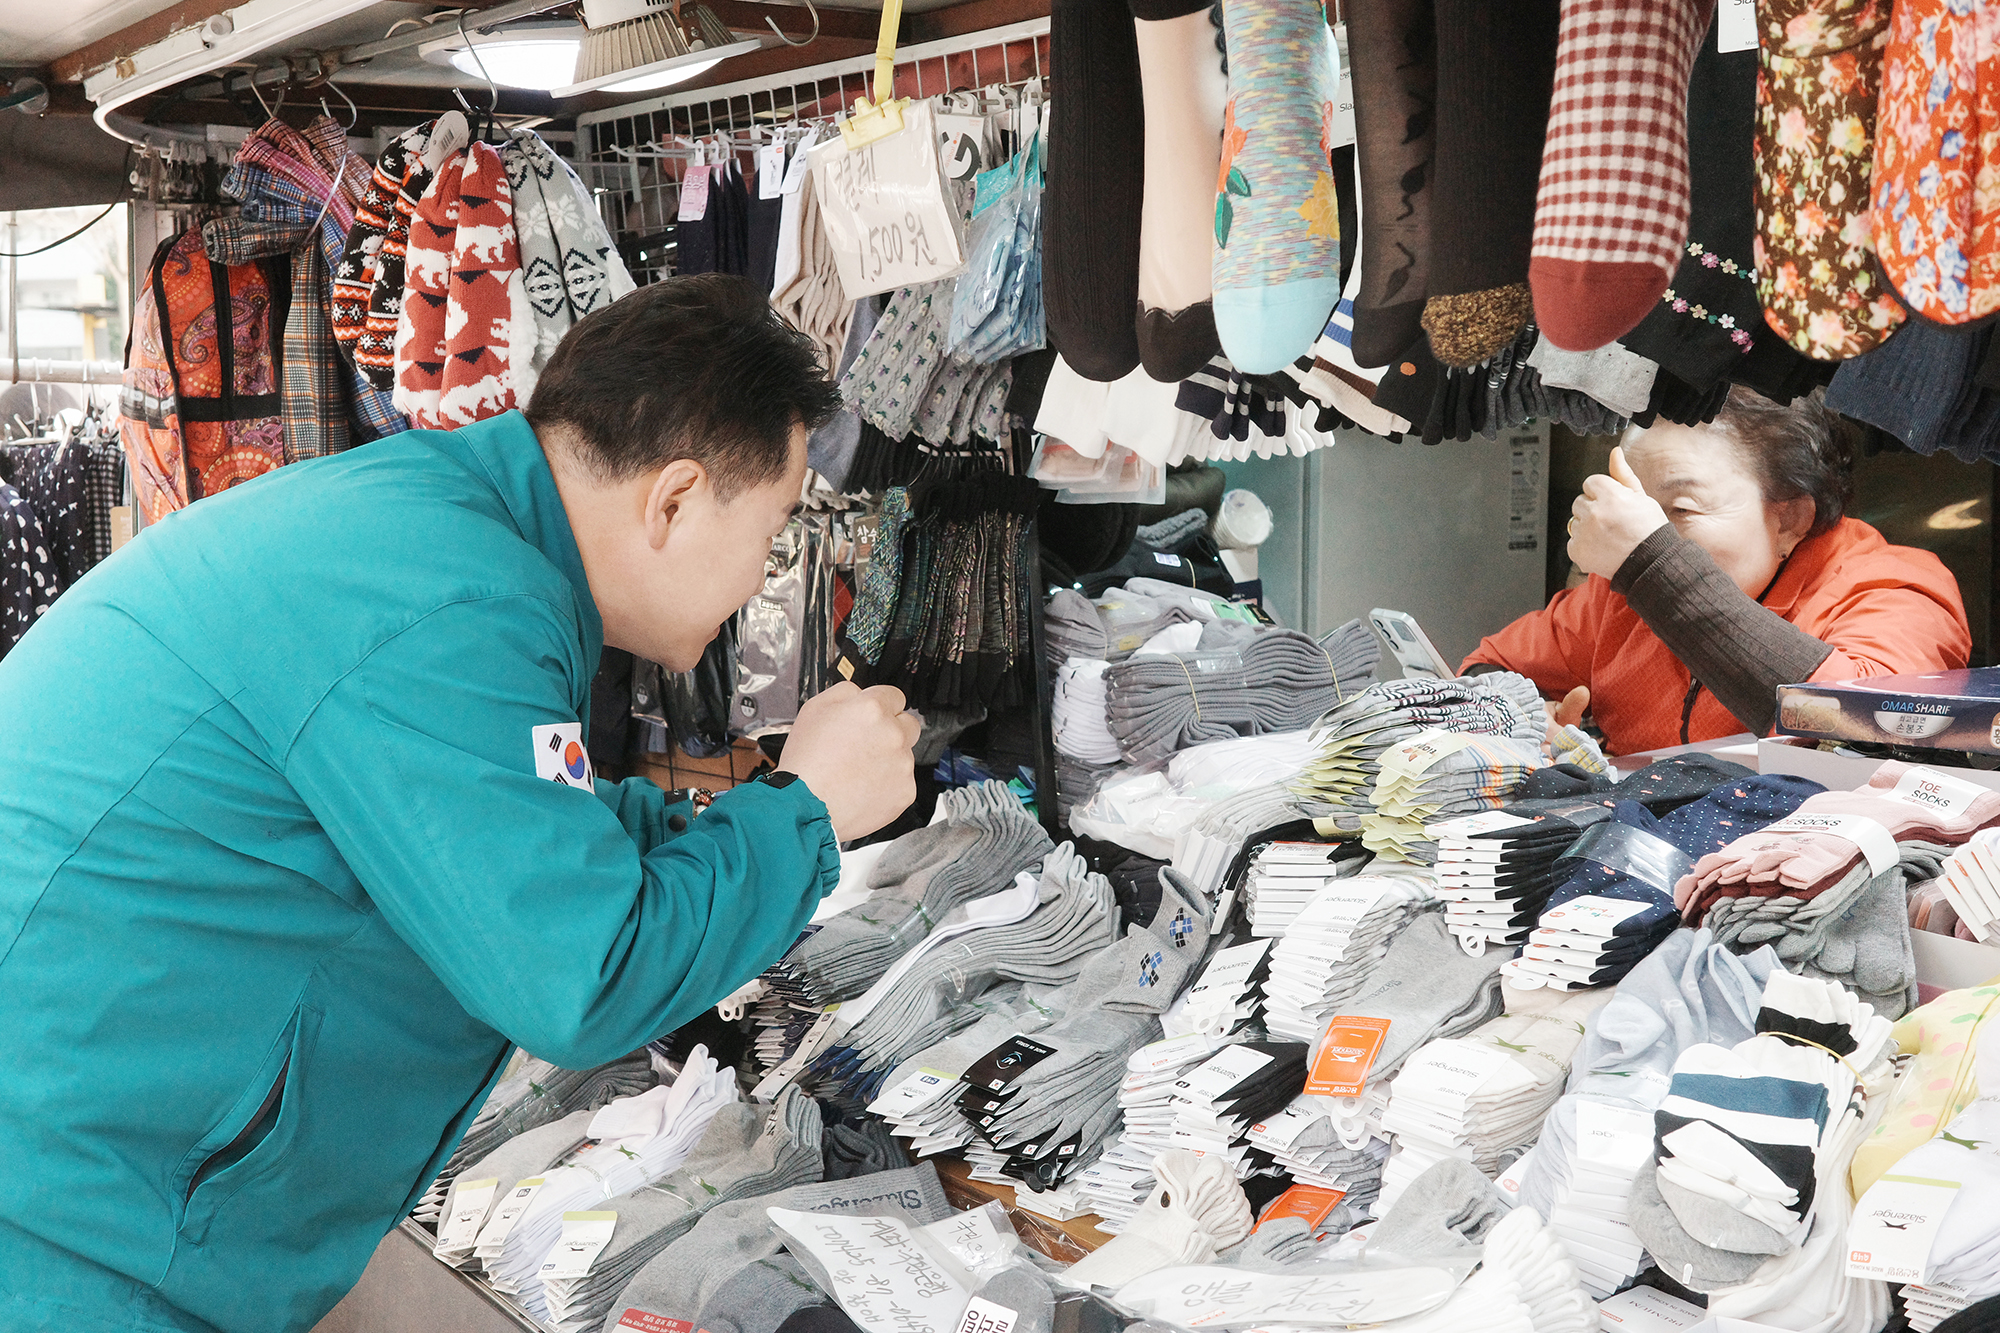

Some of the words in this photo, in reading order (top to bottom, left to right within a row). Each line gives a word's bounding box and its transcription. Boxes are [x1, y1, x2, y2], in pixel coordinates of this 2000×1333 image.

[1881, 700, 1914, 712] OMAR
[1914, 702, 1952, 715] SHARIF
[1918, 779, 1943, 794] TOE
[1911, 789, 1951, 808] SOCKS
[1323, 896, 1369, 905] Slazenger
[1425, 1060, 1480, 1079] Slazenger
[1871, 1209, 1928, 1224] Slazenger
[1647, 1294, 1670, 1306] KOREA
[1629, 1300, 1684, 1327] PREMIUM
[1679, 1308, 1699, 1319] MADE
